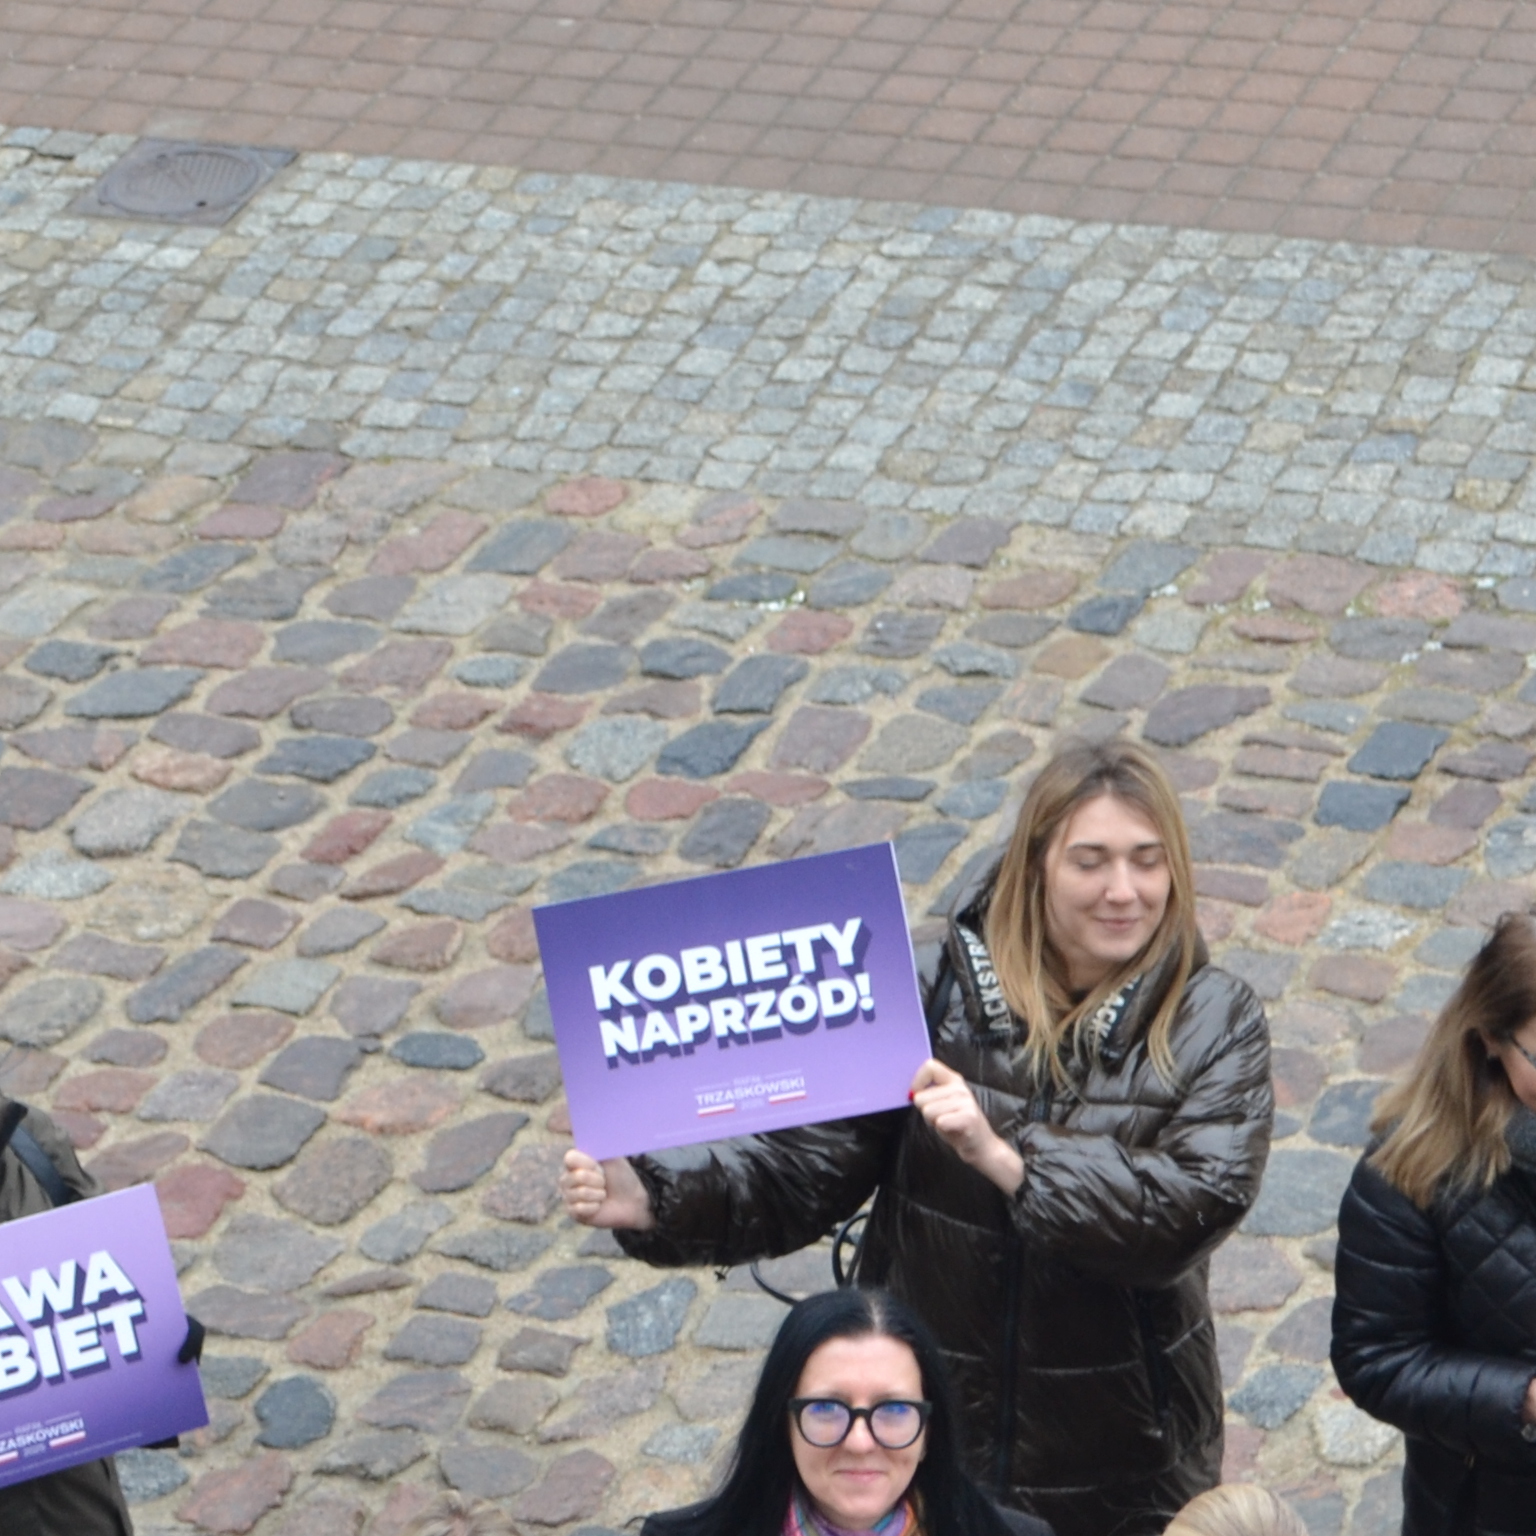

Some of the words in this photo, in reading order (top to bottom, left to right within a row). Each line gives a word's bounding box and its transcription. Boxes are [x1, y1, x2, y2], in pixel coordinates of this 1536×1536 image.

[588, 917, 863, 1012] KOBIETY
[599, 973, 875, 1058] NAPRZÓD!
[695, 1076, 805, 1106] TRZASKOWSKI
